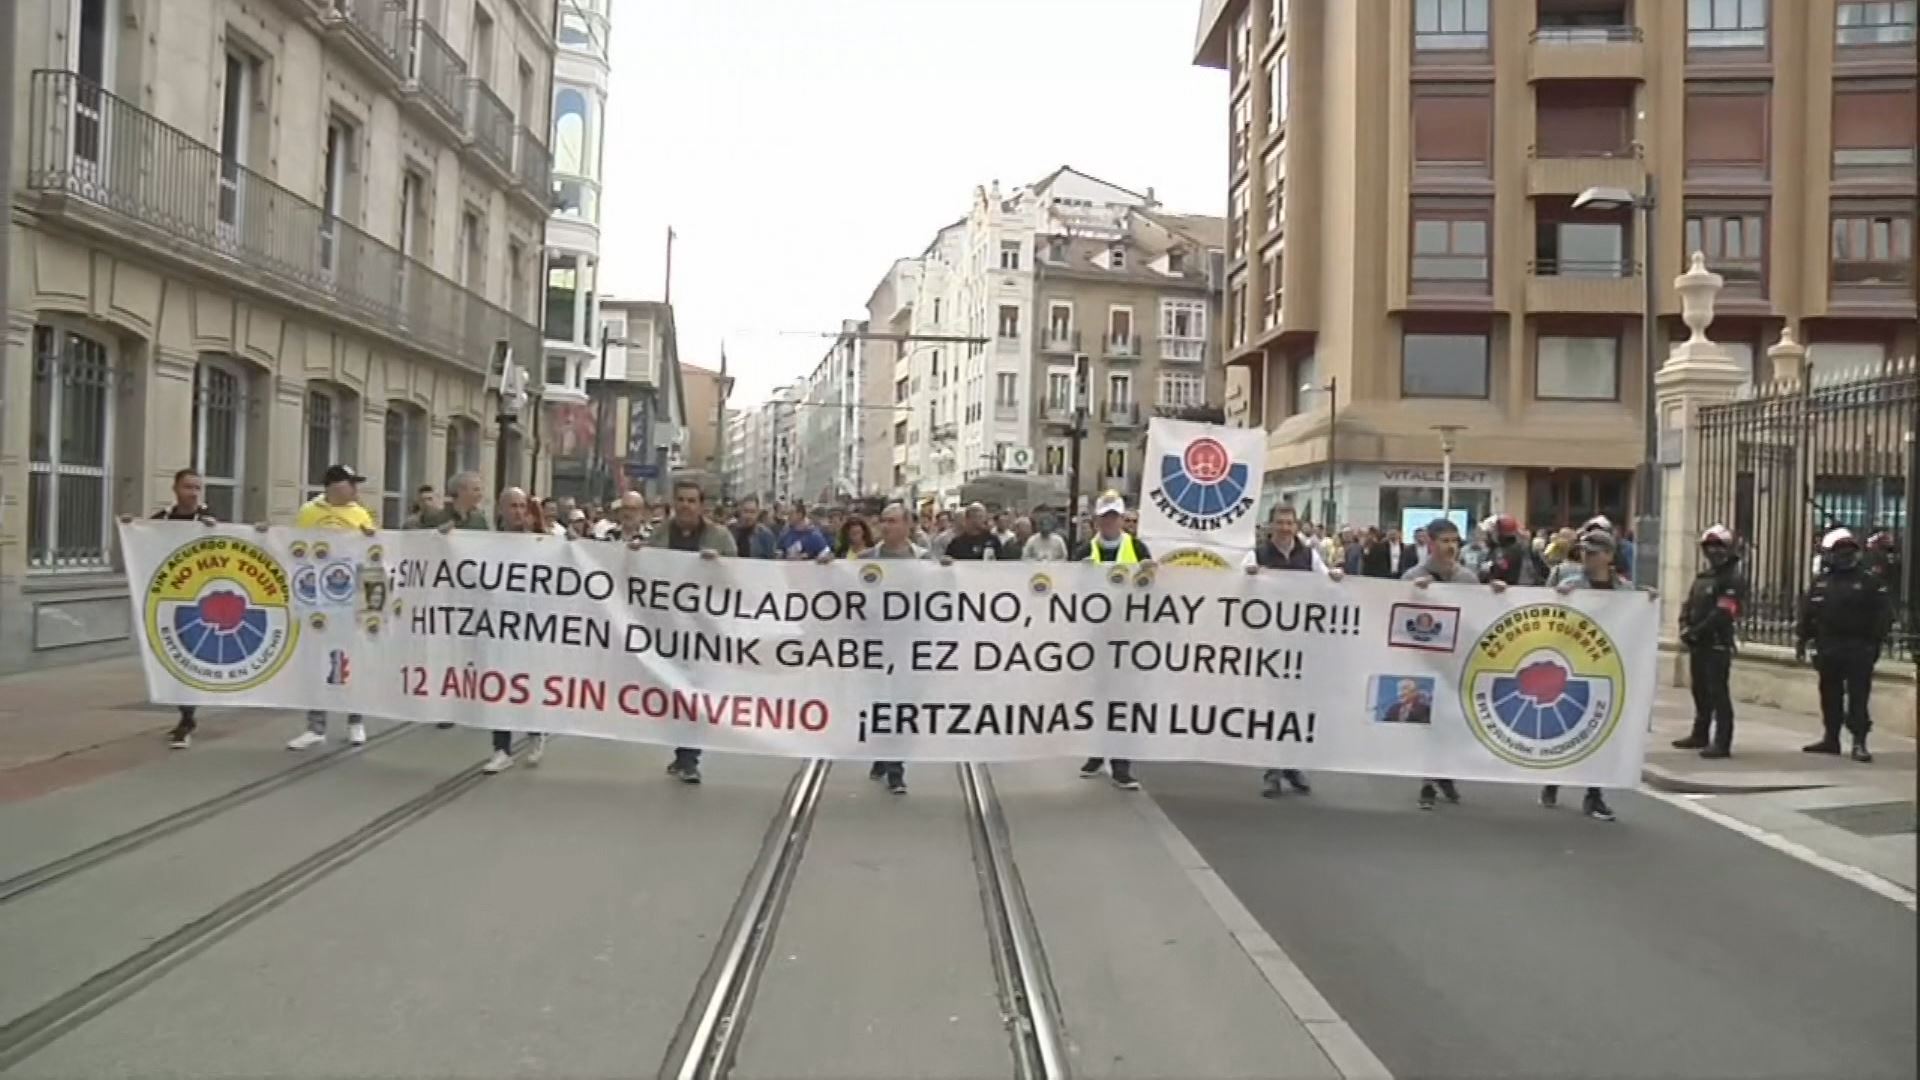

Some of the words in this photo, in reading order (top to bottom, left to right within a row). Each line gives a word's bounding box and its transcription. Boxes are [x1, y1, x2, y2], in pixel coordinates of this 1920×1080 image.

[1150, 487, 1255, 531] ERTZAINTZA
[151, 570, 168, 593] SIN
[168, 541, 226, 570] ACUERDO
[170, 566, 192, 590] NO
[196, 555, 230, 571] HAY
[237, 558, 278, 597] TOUR
[433, 559, 614, 601] ACUERDO
[628, 576, 867, 622] REGULADOR
[882, 590, 1033, 626] DIGNO,
[1048, 592, 1112, 623] NO
[1125, 594, 1205, 626] HAY
[1217, 598, 1361, 635] TOUR!!!
[228, 668, 249, 679] EN
[250, 628, 283, 671] LUCHA
[411, 606, 610, 649] HITZARMEN
[624, 624, 761, 667] DUINIK
[776, 637, 895, 675] GABE,
[911, 640, 959, 671] EZ
[974, 640, 1095, 673] DAGO
[1107, 640, 1303, 680] TOURRIK!!
[1578, 619, 1613, 653] GABE
[400, 665, 429, 696] 12
[440, 660, 531, 704] AÑOS
[542, 675, 606, 711] SIN
[617, 683, 829, 732] CONVENIO
[857, 700, 1095, 742] ¡ERTZAINAS
[1107, 701, 1158, 734] EN
[1170, 705, 1317, 744] LUCHA!
